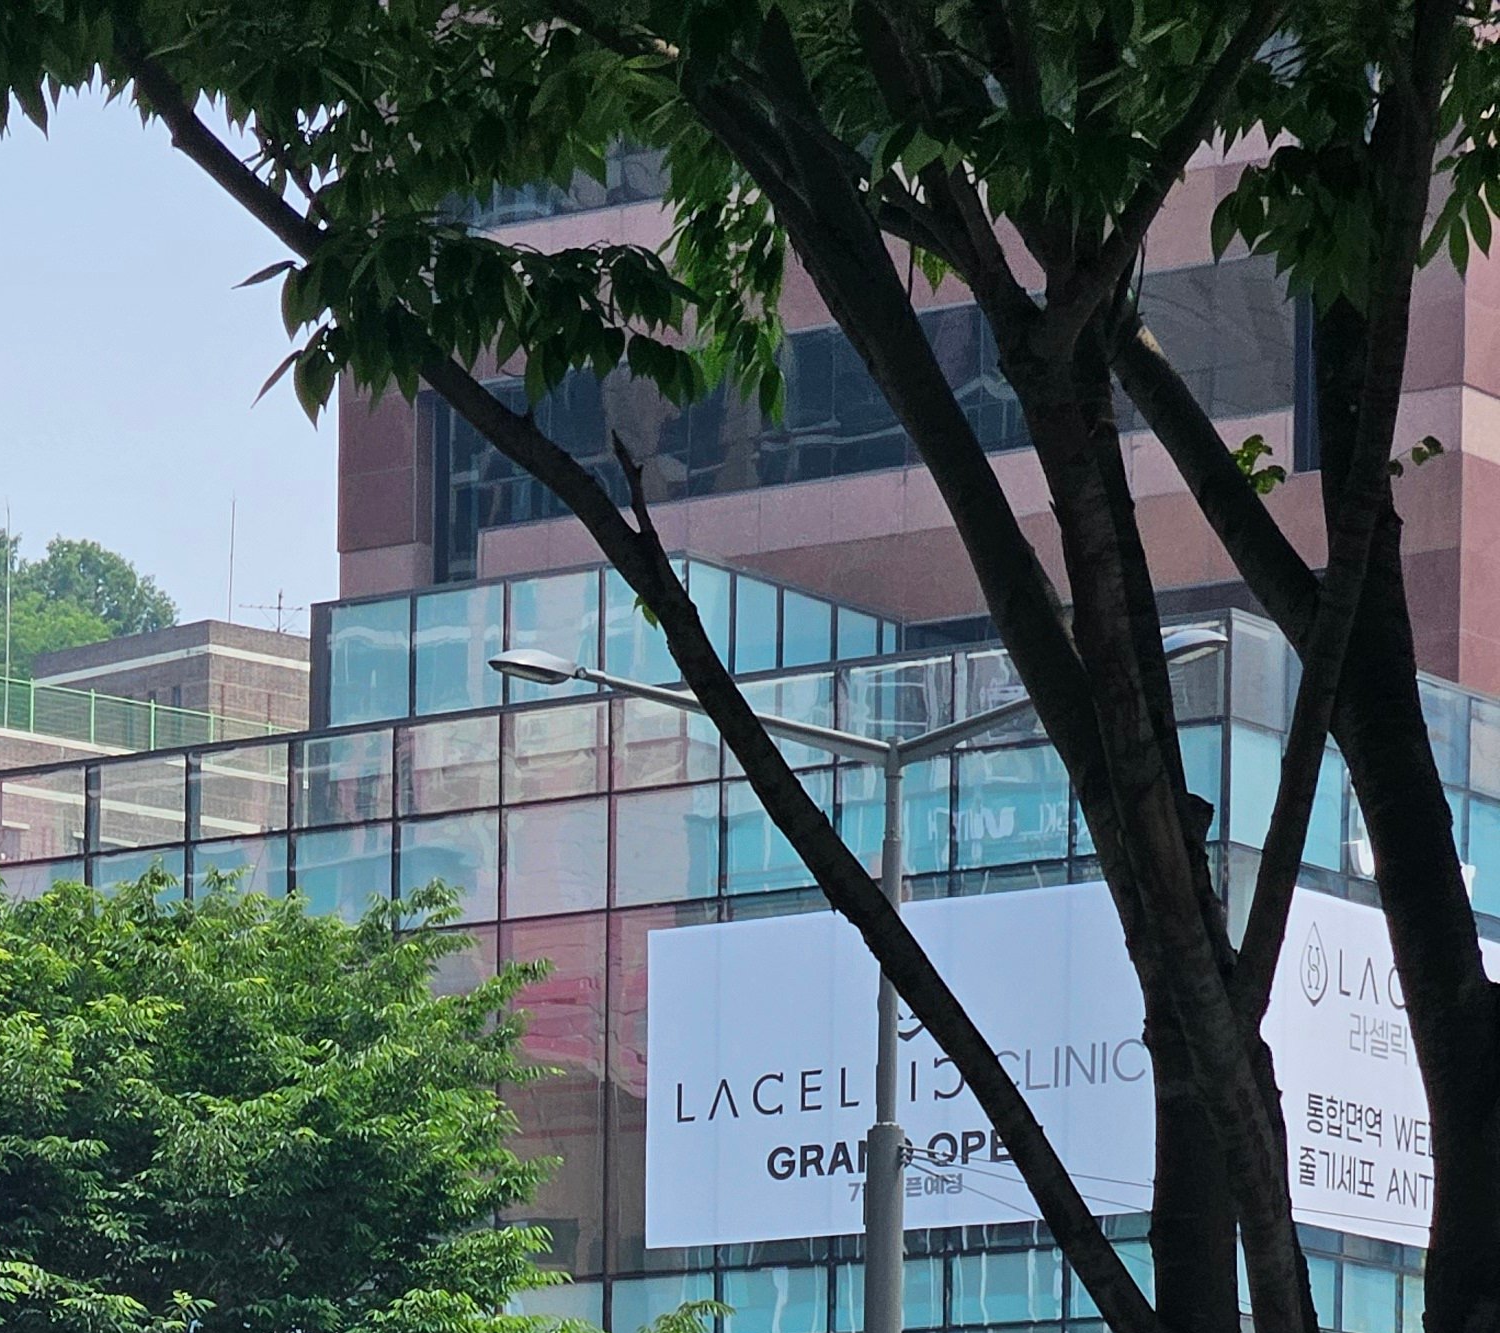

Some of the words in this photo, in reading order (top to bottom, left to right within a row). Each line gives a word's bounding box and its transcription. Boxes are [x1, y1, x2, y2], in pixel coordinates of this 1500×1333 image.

[1350, 1013, 1408, 1065] 라셀릭
[1306, 1092, 1383, 1147] 통합면역
[927, 1128, 1014, 1166] OPE
[906, 1173, 963, 1197] 픈예정
[1299, 1145, 1376, 1199] 줄기세포
[1386, 1167, 1434, 1210] ANT
